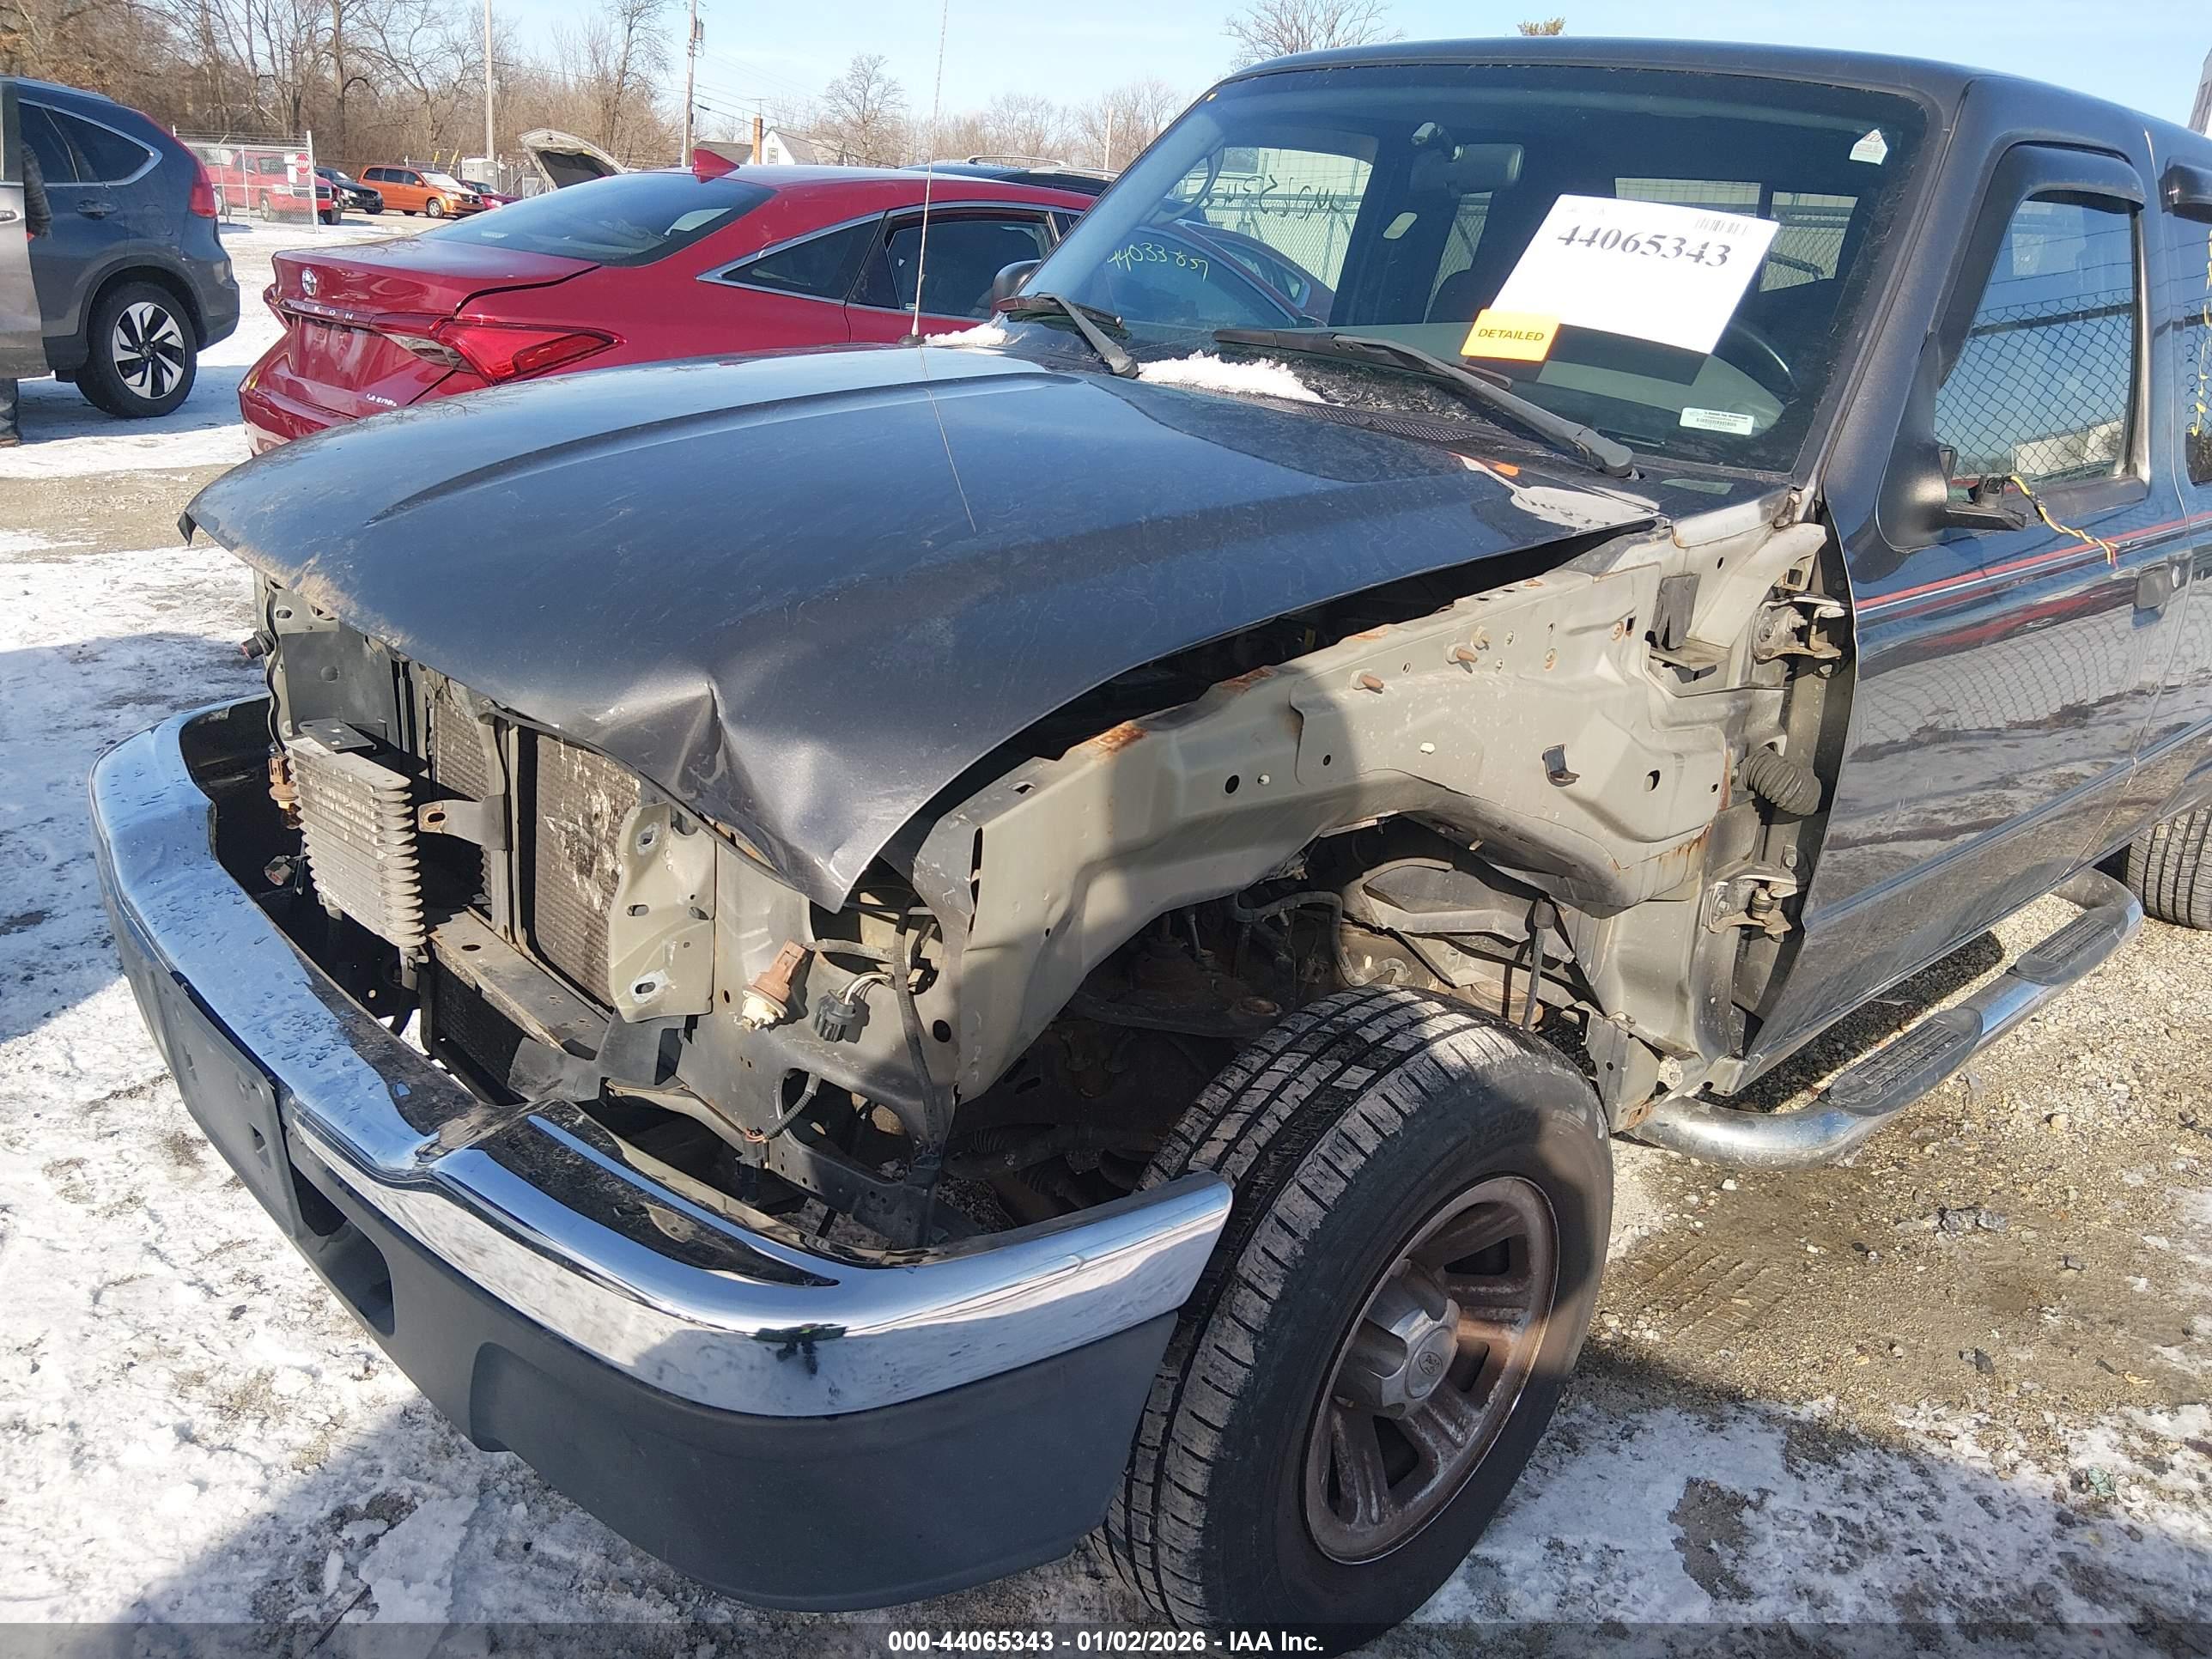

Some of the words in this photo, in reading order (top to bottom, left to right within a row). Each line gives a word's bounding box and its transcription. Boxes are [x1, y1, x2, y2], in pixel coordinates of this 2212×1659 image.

[295, 159, 310, 169] STOP
[1557, 225, 1732, 267] 44065343
[1477, 328, 1546, 343] DETAILED
